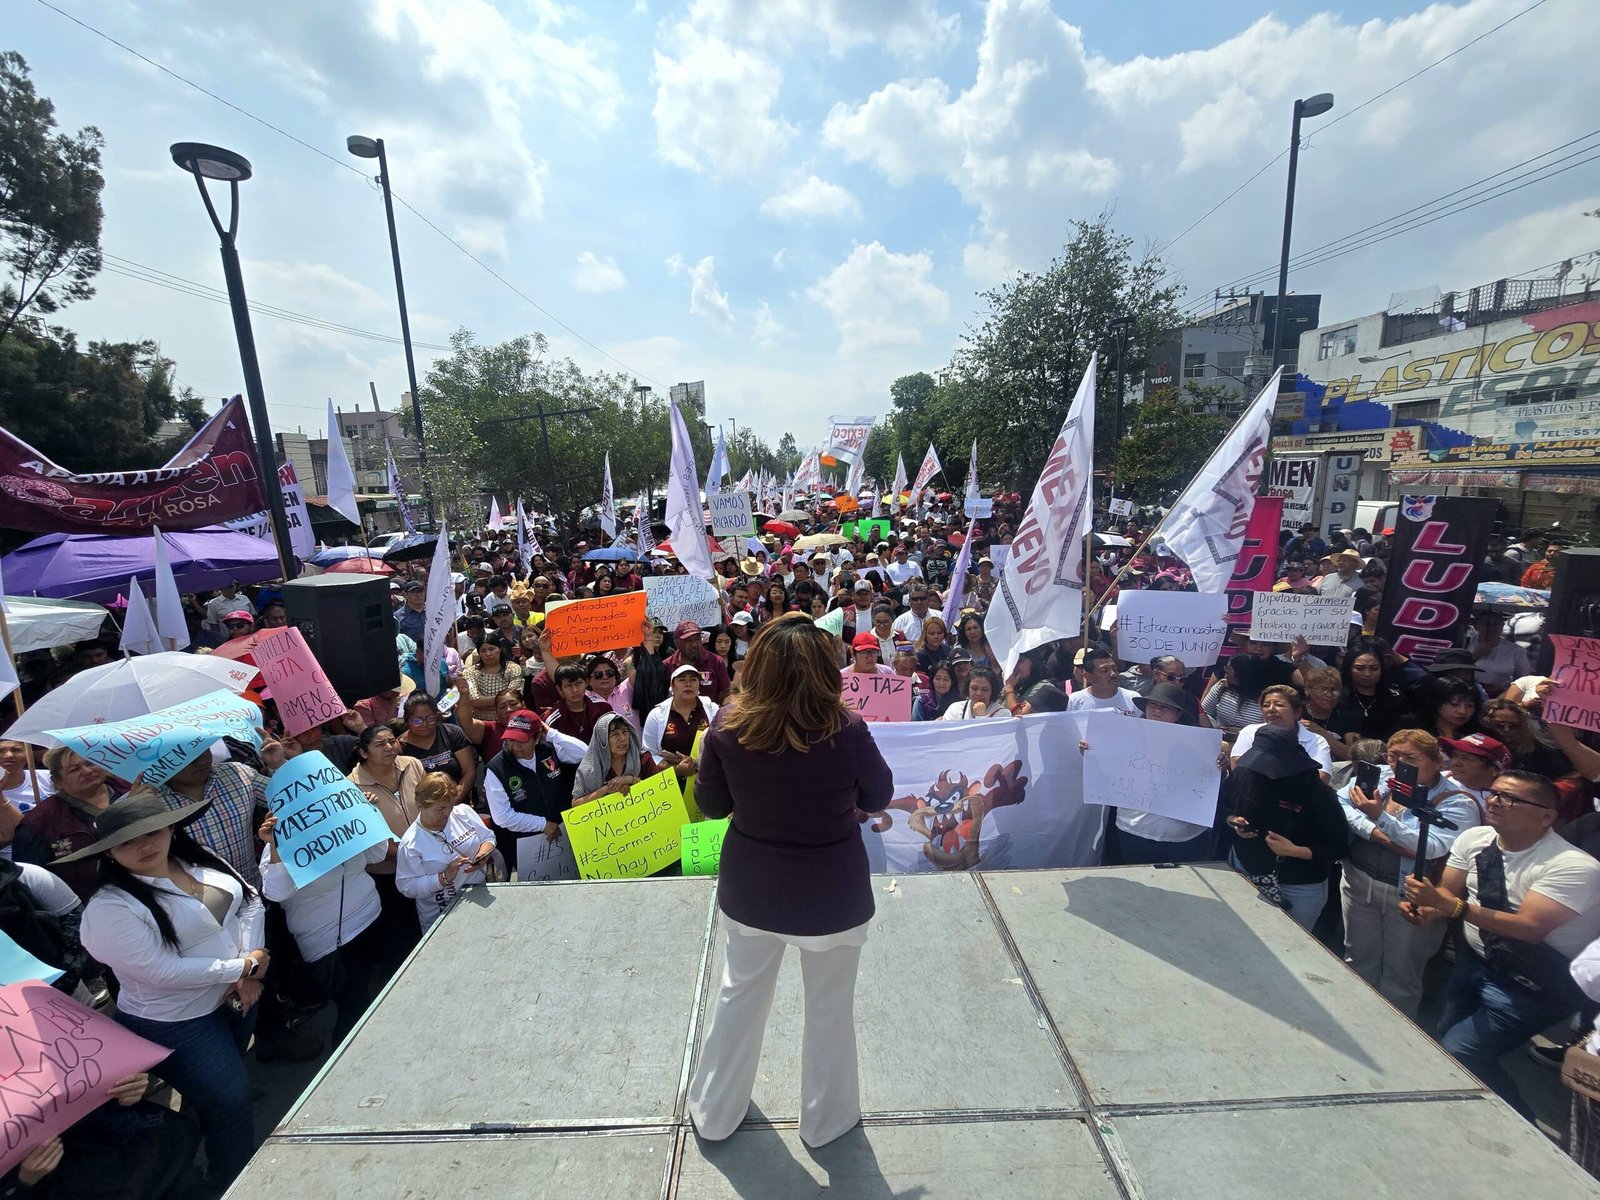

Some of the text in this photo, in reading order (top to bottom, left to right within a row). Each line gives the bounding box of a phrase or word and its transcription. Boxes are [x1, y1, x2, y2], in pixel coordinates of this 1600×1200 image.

[164, 493, 222, 518] ROSA
[713, 495, 745, 510] VAMOS
[713, 513, 747, 529] RICARDO
[658, 576, 702, 587] GRACIAS
[623, 595, 636, 605] de
[1259, 593, 1349, 606] Diputada Carmen
[567, 610, 628, 625] Mercados
[1257, 606, 1348, 618] Gracias por su
[1257, 618, 1296, 630] trabajo
[1301, 622, 1308, 631] a
[575, 637, 599, 649] hay
[1259, 631, 1296, 641] nuestra
[1128, 637, 1219, 653] 30 DE JUNIO
[869, 677, 906, 695] TAZ
[303, 698, 343, 727] ROS
[87, 721, 174, 770] RICARDO
[567, 772, 675, 826] Cordinadora de
[594, 800, 672, 843] Mercados
[451, 827, 476, 846] morena
[616, 857, 648, 877] hay
[653, 838, 680, 860] más
